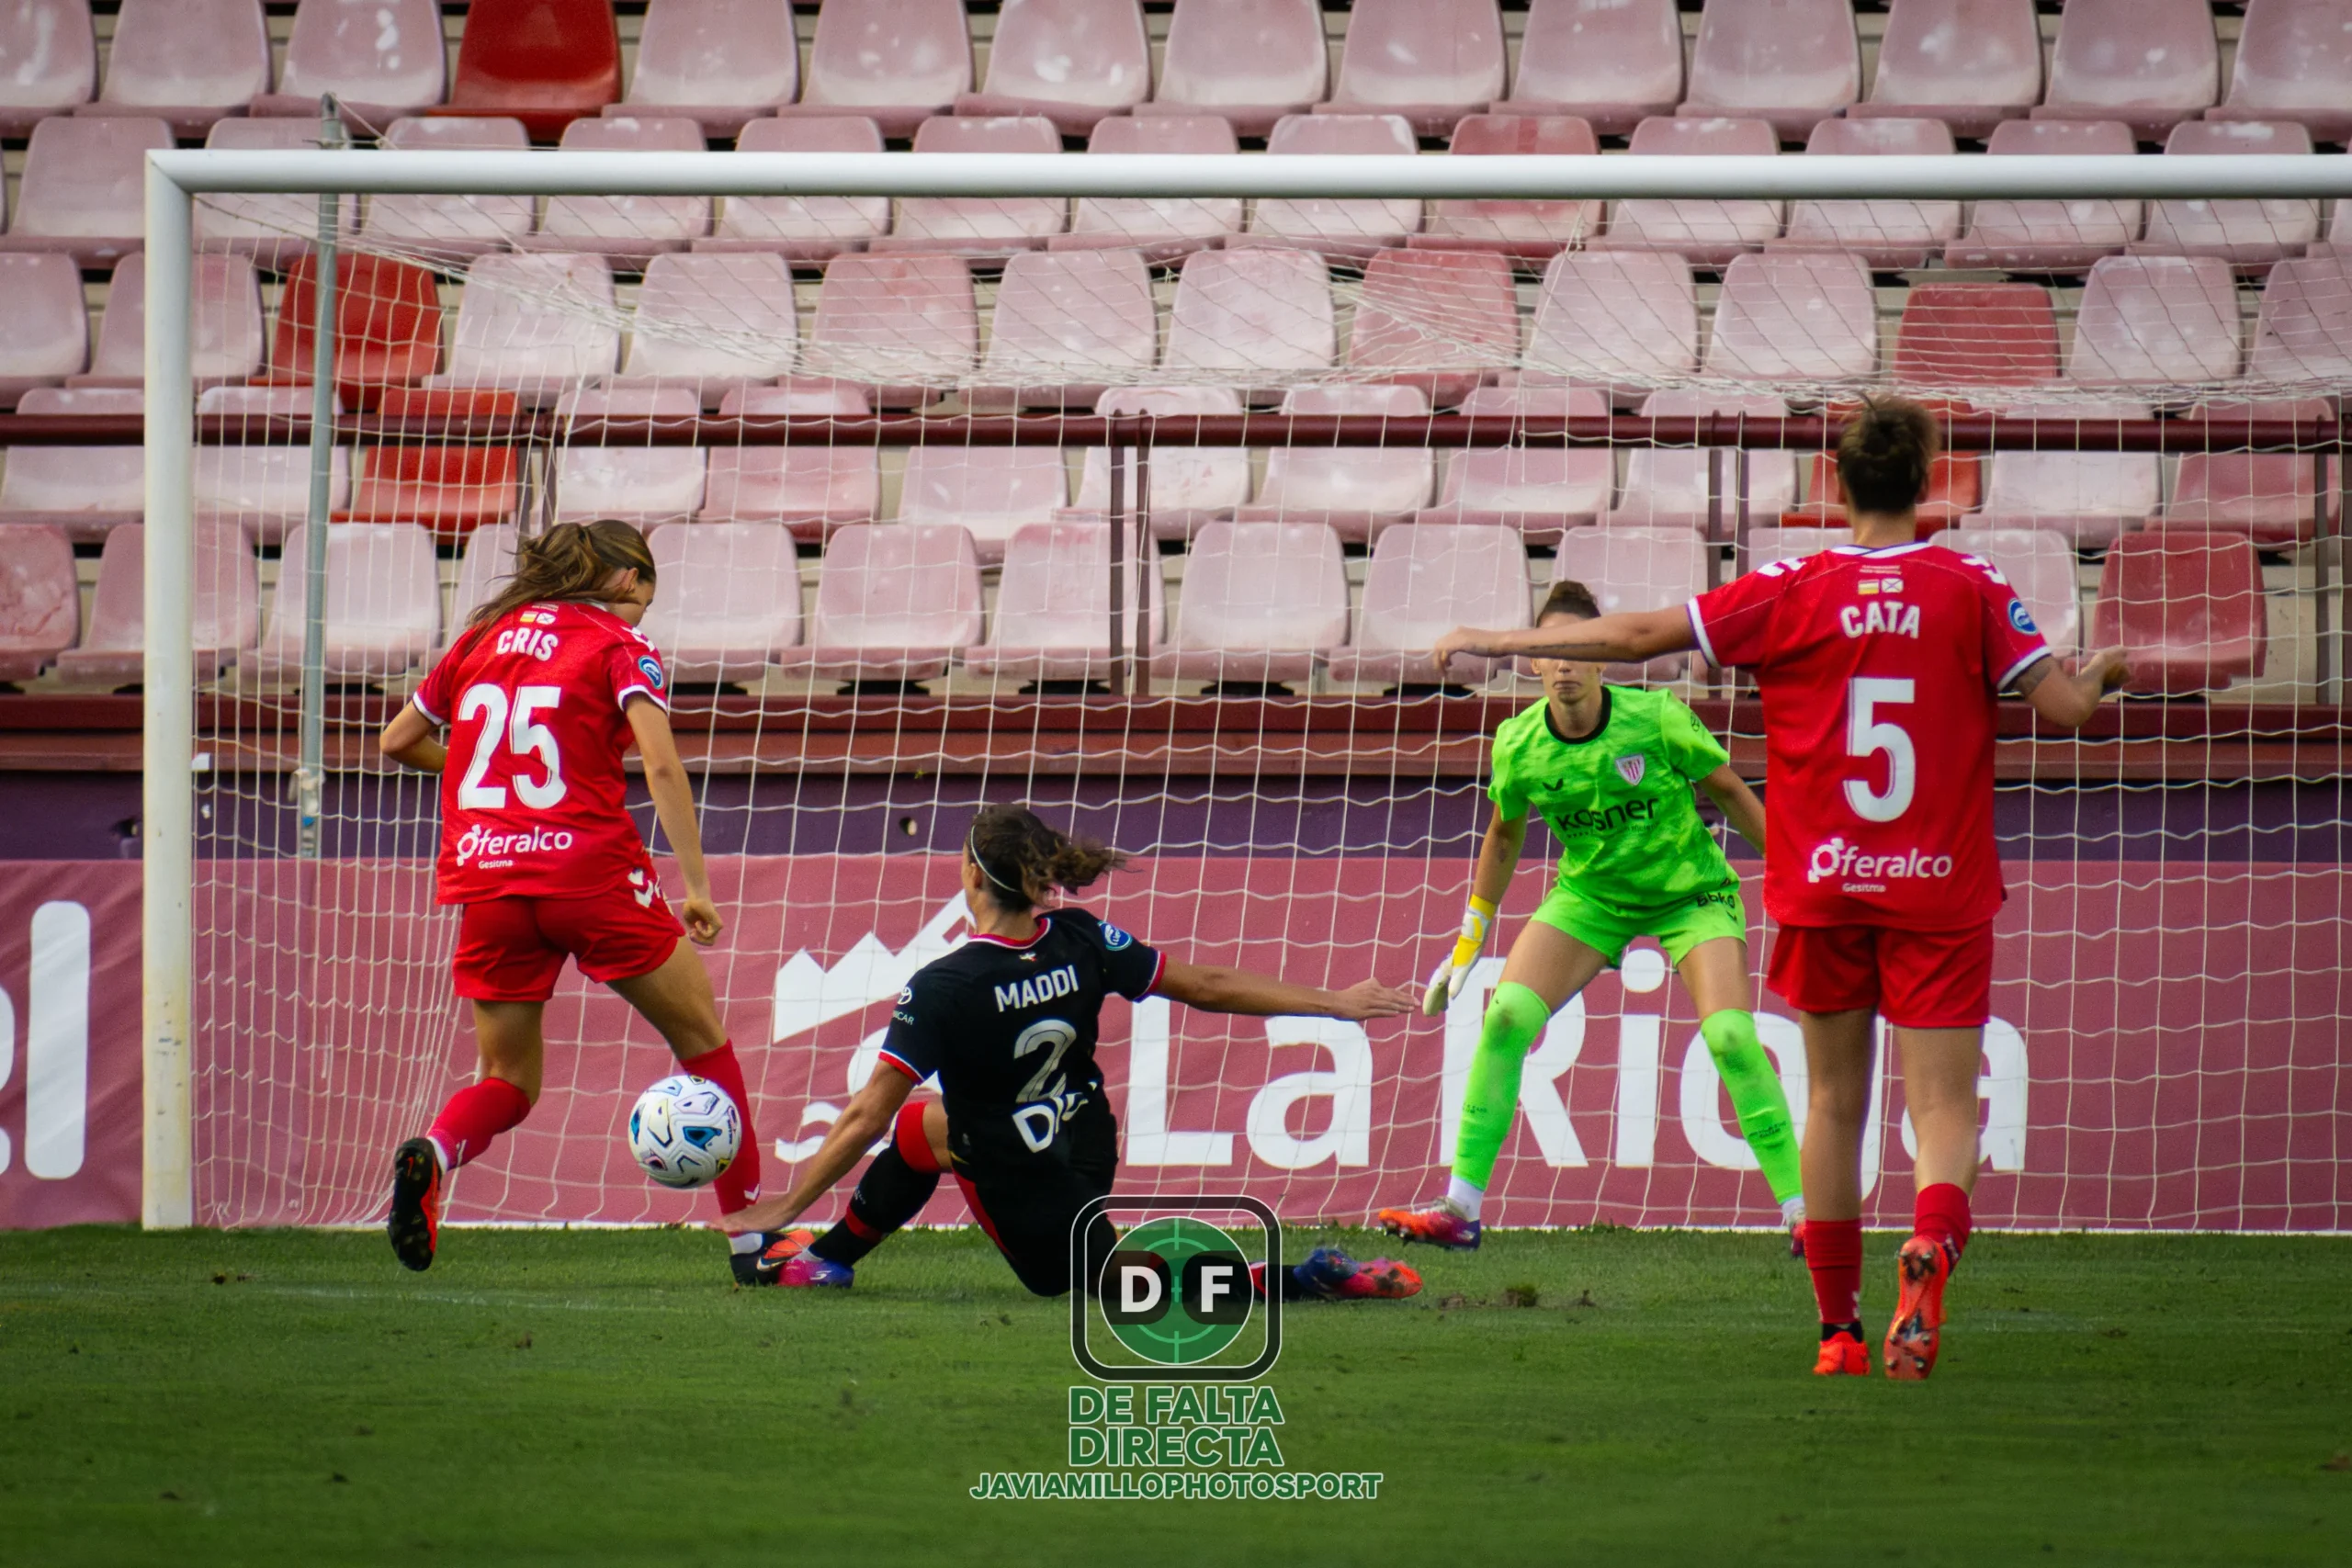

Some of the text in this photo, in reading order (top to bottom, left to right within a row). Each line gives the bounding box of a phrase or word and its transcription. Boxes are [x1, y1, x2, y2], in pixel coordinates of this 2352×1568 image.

[495, 626, 559, 662] CRIS
[1840, 600, 1921, 639] CATA
[458, 682, 568, 811] 25
[1843, 677, 1917, 823] 5
[1555, 797, 1659, 832] kosner
[994, 964, 1080, 1013] MADDI
[1013, 1018, 1078, 1104] 2
[1125, 948, 2029, 1202] La Rioa
